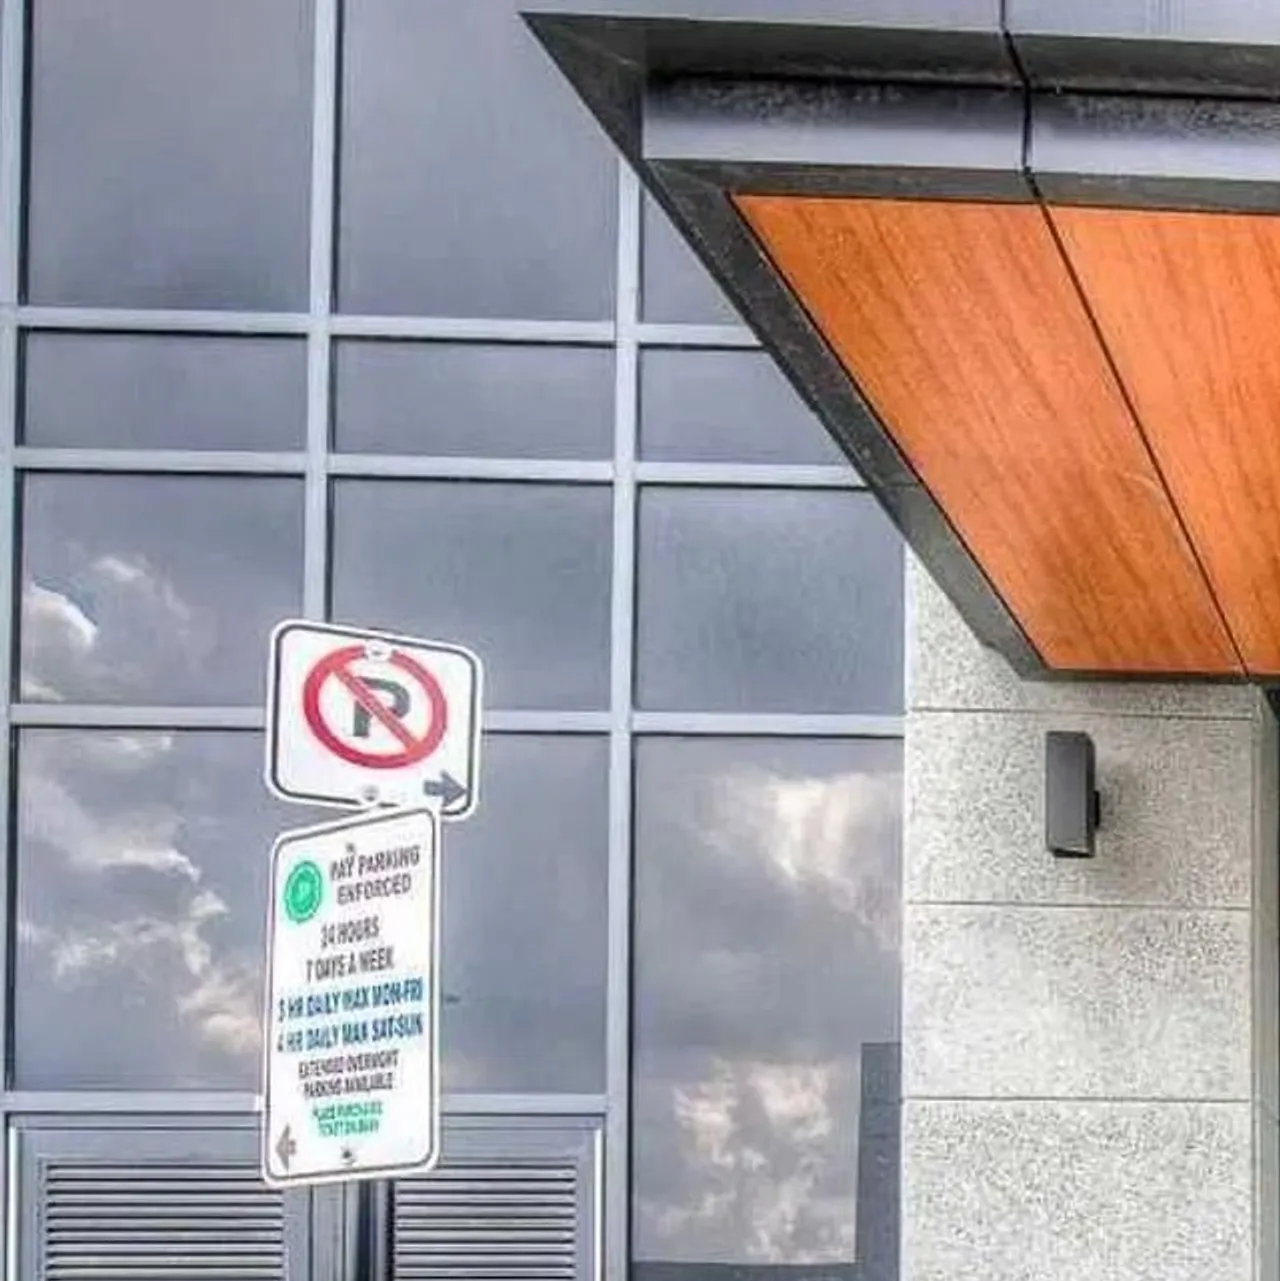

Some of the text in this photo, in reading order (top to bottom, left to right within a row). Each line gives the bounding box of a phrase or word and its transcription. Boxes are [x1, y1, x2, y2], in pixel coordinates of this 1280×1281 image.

[358, 844, 421, 877] PARKING
[337, 872, 412, 906] ENFORCED
[337, 914, 380, 945] HOURS
[359, 945, 394, 972] WEEK
[306, 990, 342, 1017] DAILY
